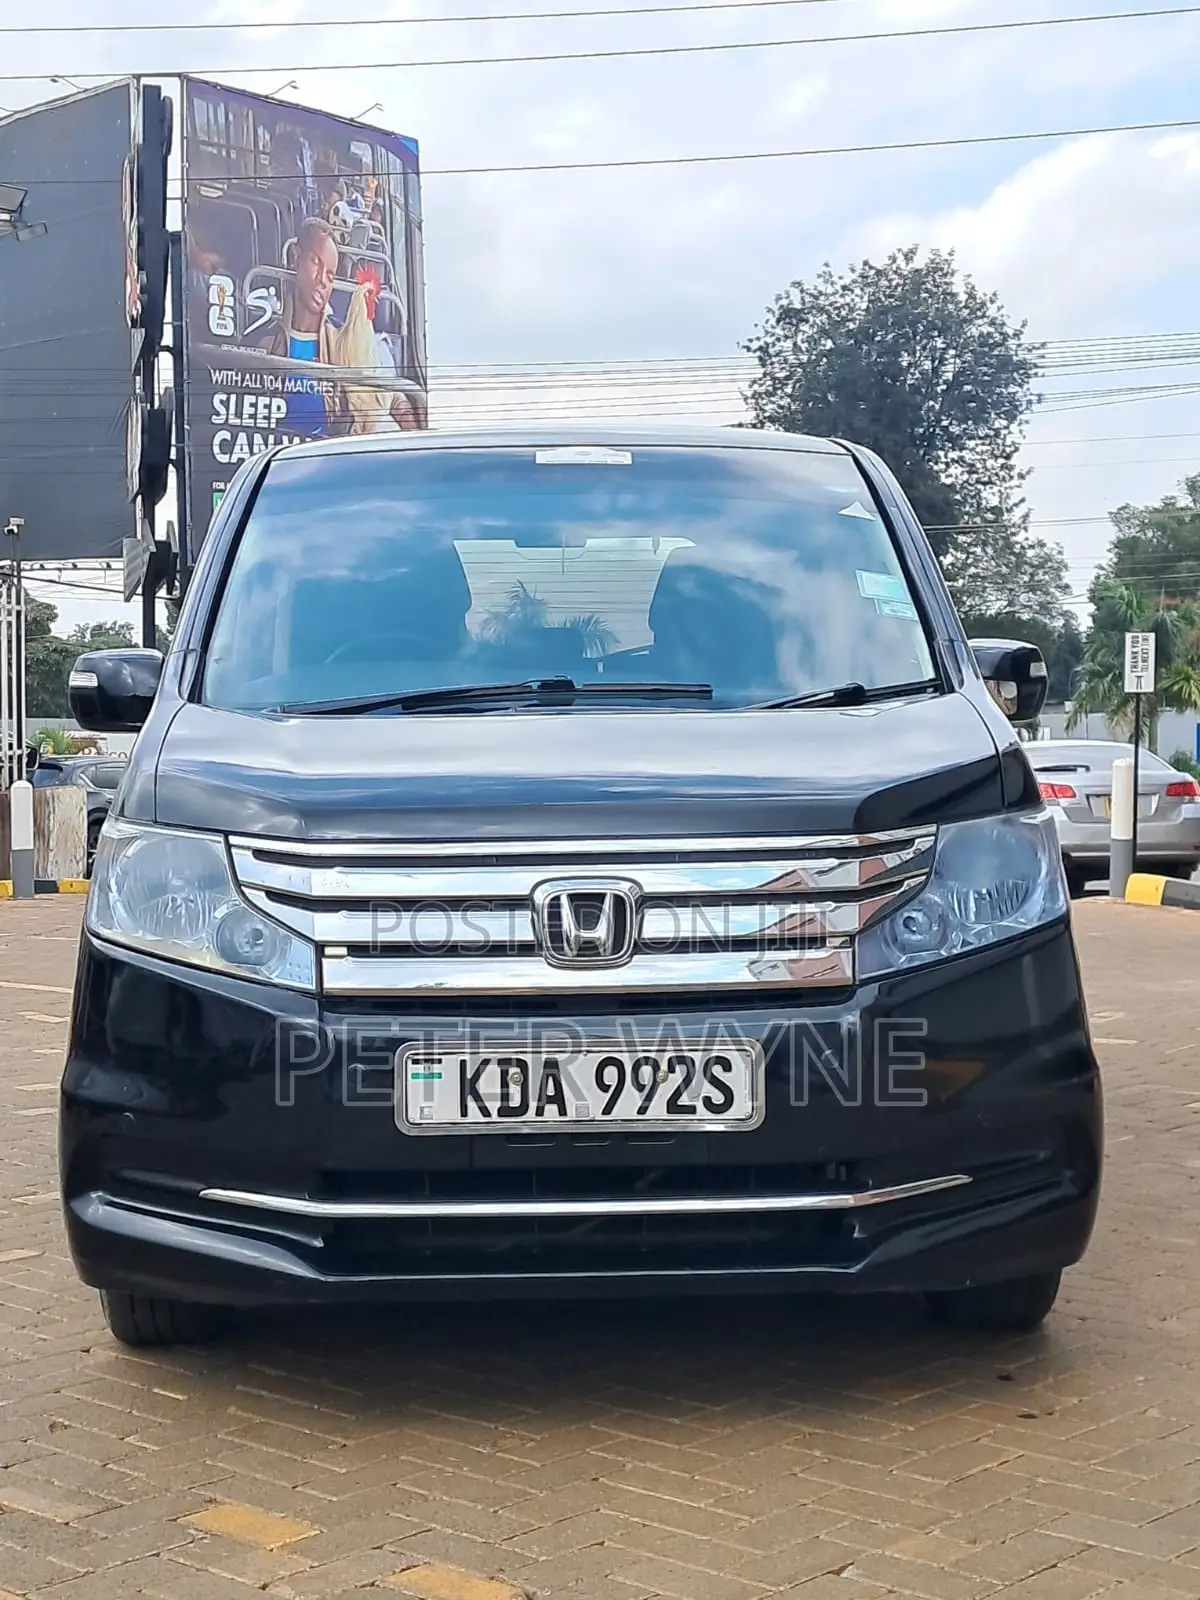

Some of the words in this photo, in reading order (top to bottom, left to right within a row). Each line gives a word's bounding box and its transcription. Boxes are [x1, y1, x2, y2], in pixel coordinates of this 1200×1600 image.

[210, 368, 242, 387] WITH
[243, 372, 262, 389] ALL
[263, 375, 283, 392] 104
[211, 391, 288, 429] SLEEP
[1131, 635, 1140, 649] YOU
[1130, 651, 1139, 673] THANK
[1141, 648, 1149, 664] NEXT
[458, 1056, 568, 1117] KDA
[595, 1055, 735, 1115] 992S
